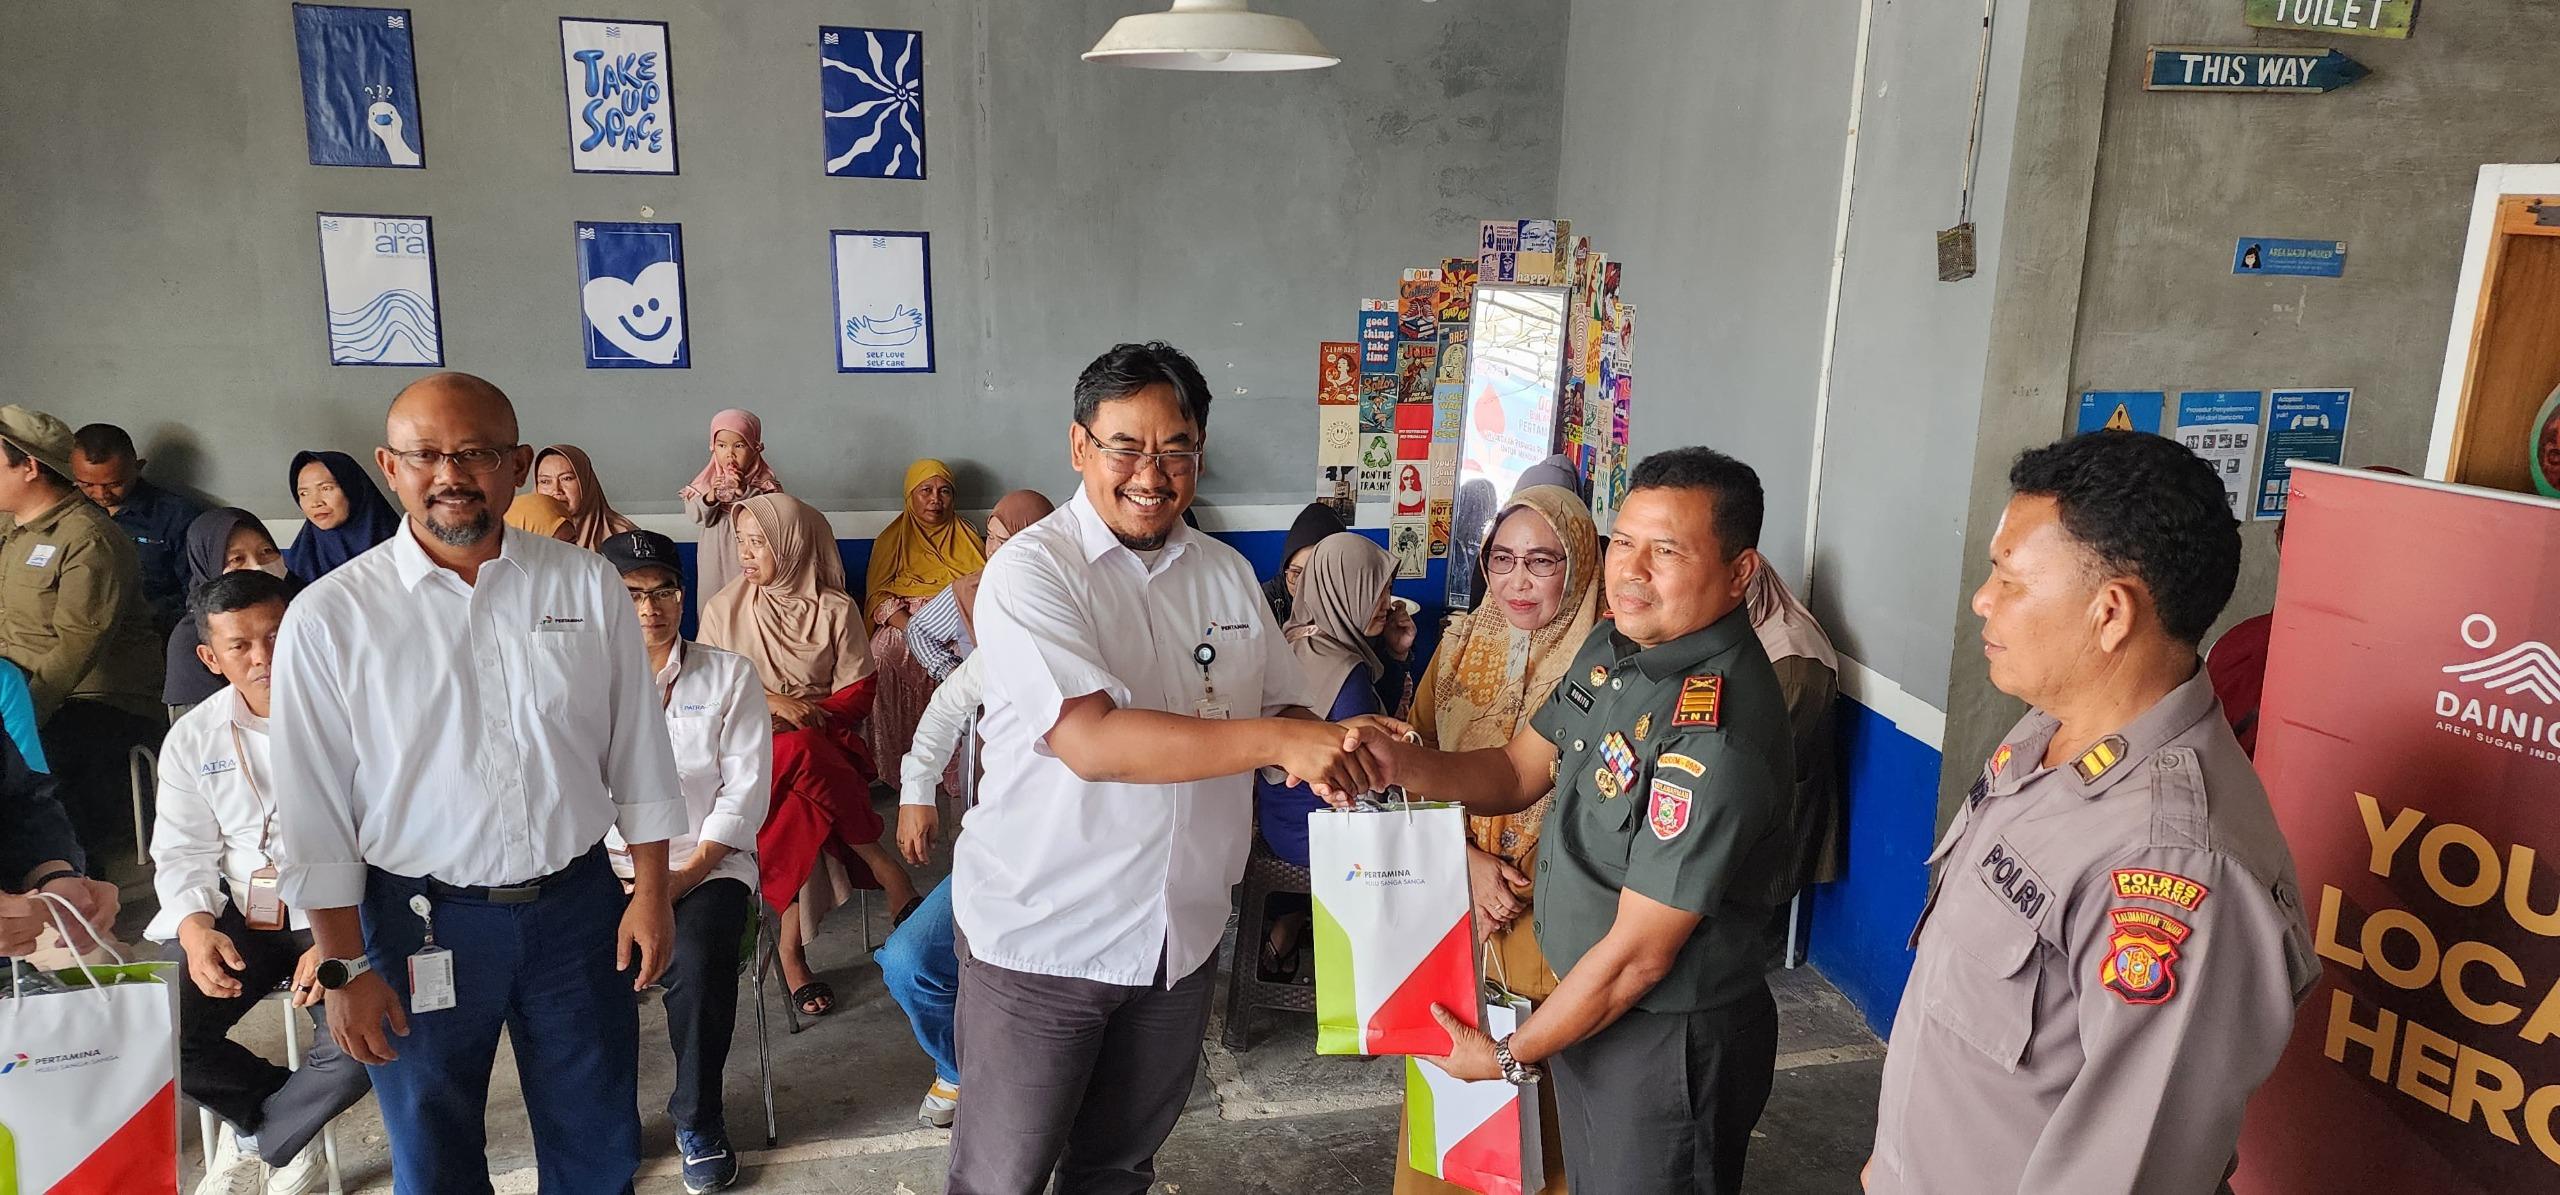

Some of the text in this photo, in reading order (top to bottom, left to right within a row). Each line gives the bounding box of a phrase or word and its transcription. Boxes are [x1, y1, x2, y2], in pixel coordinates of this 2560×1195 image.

[573, 49, 658, 99] TAKE
[2179, 54, 2319, 86] THIS WAY
[621, 81, 660, 116] UP
[580, 98, 664, 153] SPACE
[374, 221, 424, 235] moo
[375, 235, 425, 254] ara
[1366, 317, 1389, 328] good
[1363, 329, 1395, 341] things
[1367, 341, 1389, 352] take
[1366, 352, 1389, 362] time
[1679, 713, 1710, 721] TNI
[2435, 721, 2471, 738] AREN
[2476, 732, 2523, 752] SUGAR
[200, 759, 236, 772] ATRA
[1364, 869, 1412, 879] PERTAMINA
[1982, 844, 2045, 919] POLRI
[2118, 873, 2198, 899] POLRES
[2121, 884, 2191, 906] BONTANG
[35, 1049, 101, 1065] PERTAMINA
